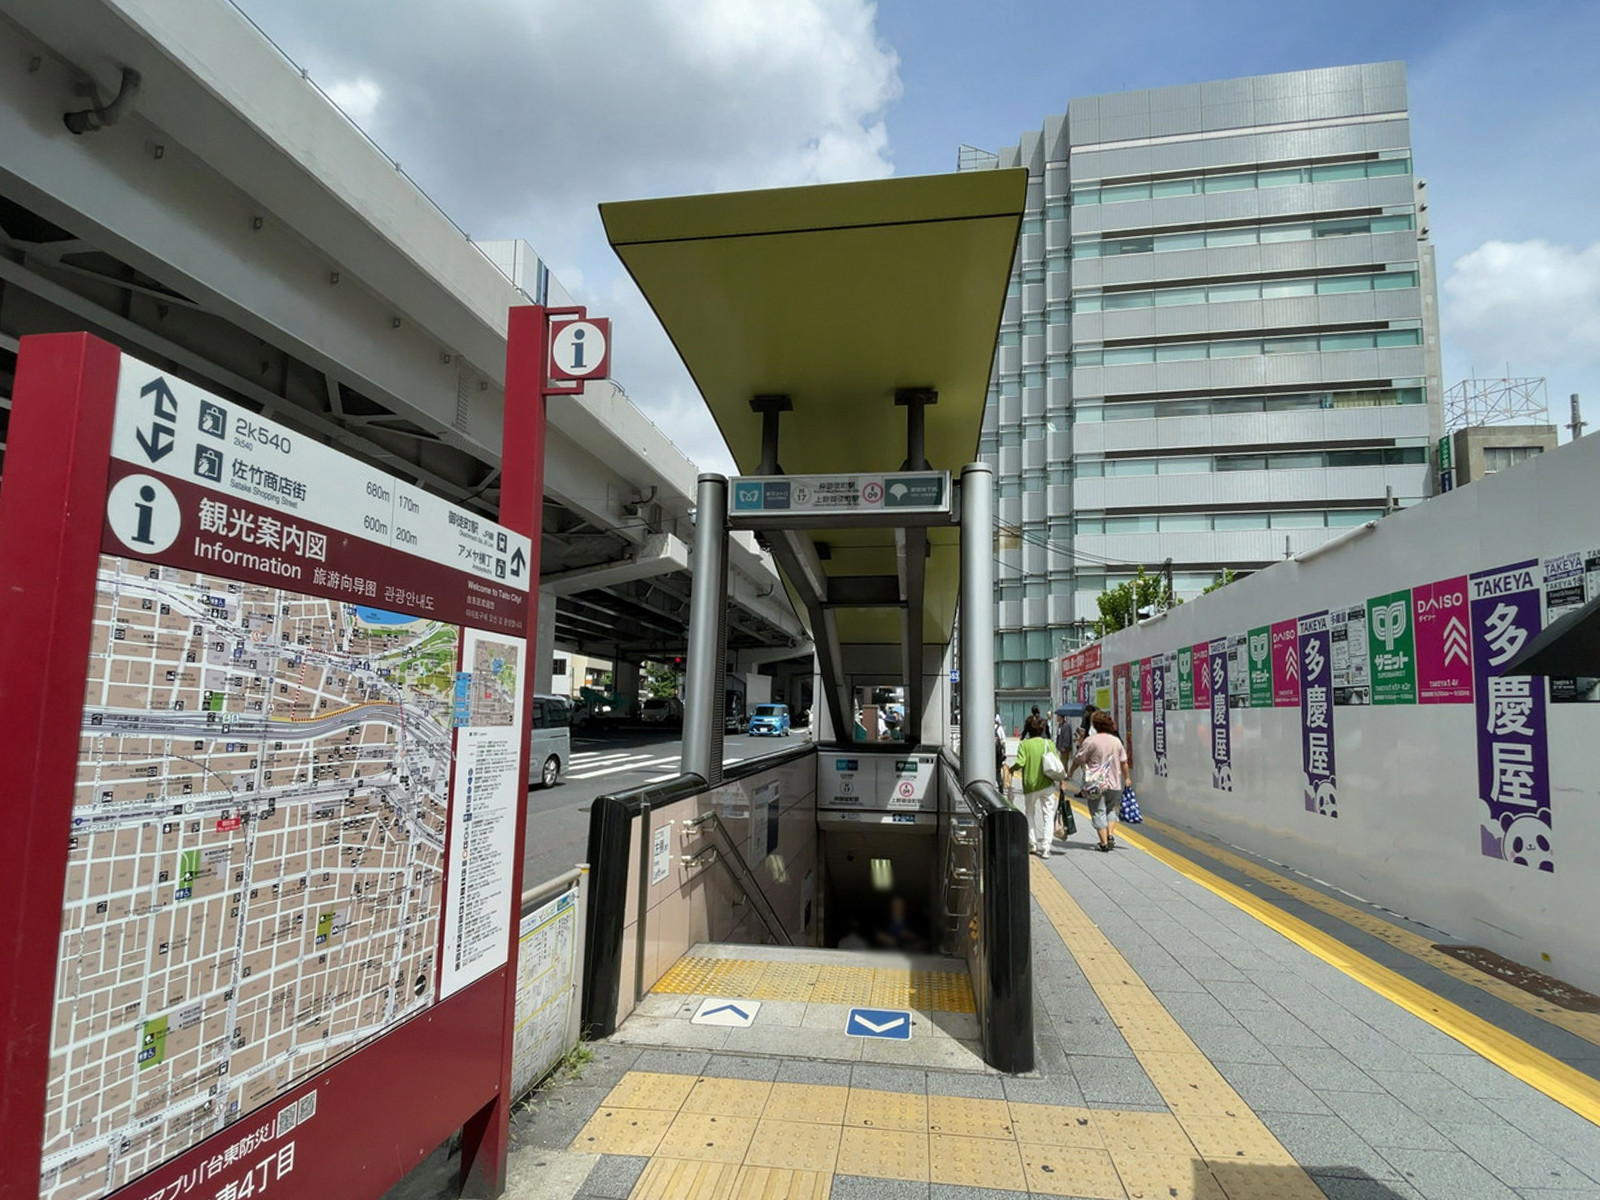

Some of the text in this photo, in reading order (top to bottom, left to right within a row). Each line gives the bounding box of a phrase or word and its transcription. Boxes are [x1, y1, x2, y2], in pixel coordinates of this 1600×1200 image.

[233, 437, 253, 452] 2k540
[235, 418, 292, 454] 2k540
[232, 458, 307, 501] 佐竹商店街
[366, 481, 390, 503] 680m
[230, 478, 298, 509] Satake Shopping Street
[399, 495, 420, 514] 170m
[198, 497, 328, 563] 観光案内図
[364, 515, 388, 536] 600m
[396, 527, 418, 546] 200m
[194, 536, 302, 580] Information
[458, 544, 493, 567] アメヤ横丁
[1544, 556, 1582, 575] TAKEYA
[313, 567, 377, 598] 旅游向导图
[467, 580, 492, 595] Welcome
[492, 589, 498, 597] to
[498, 589, 510, 600] Taito
[1474, 571, 1533, 597] TAKEYA
[384, 586, 435, 611] 관광안내도
[1417, 592, 1463, 613] DAISO
[1272, 630, 1295, 643] DAISO
[1300, 619, 1327, 633] TAKEYA
[1374, 651, 1409, 671] サミット
[1212, 656, 1228, 761] 多慶屋
[1304, 637, 1330, 777] 多慶屋
[1483, 603, 1537, 808] 多慶屋
[144, 1119, 276, 1200] アプリ「台東防災」
[208, 1141, 295, 1200] 東4丁目
